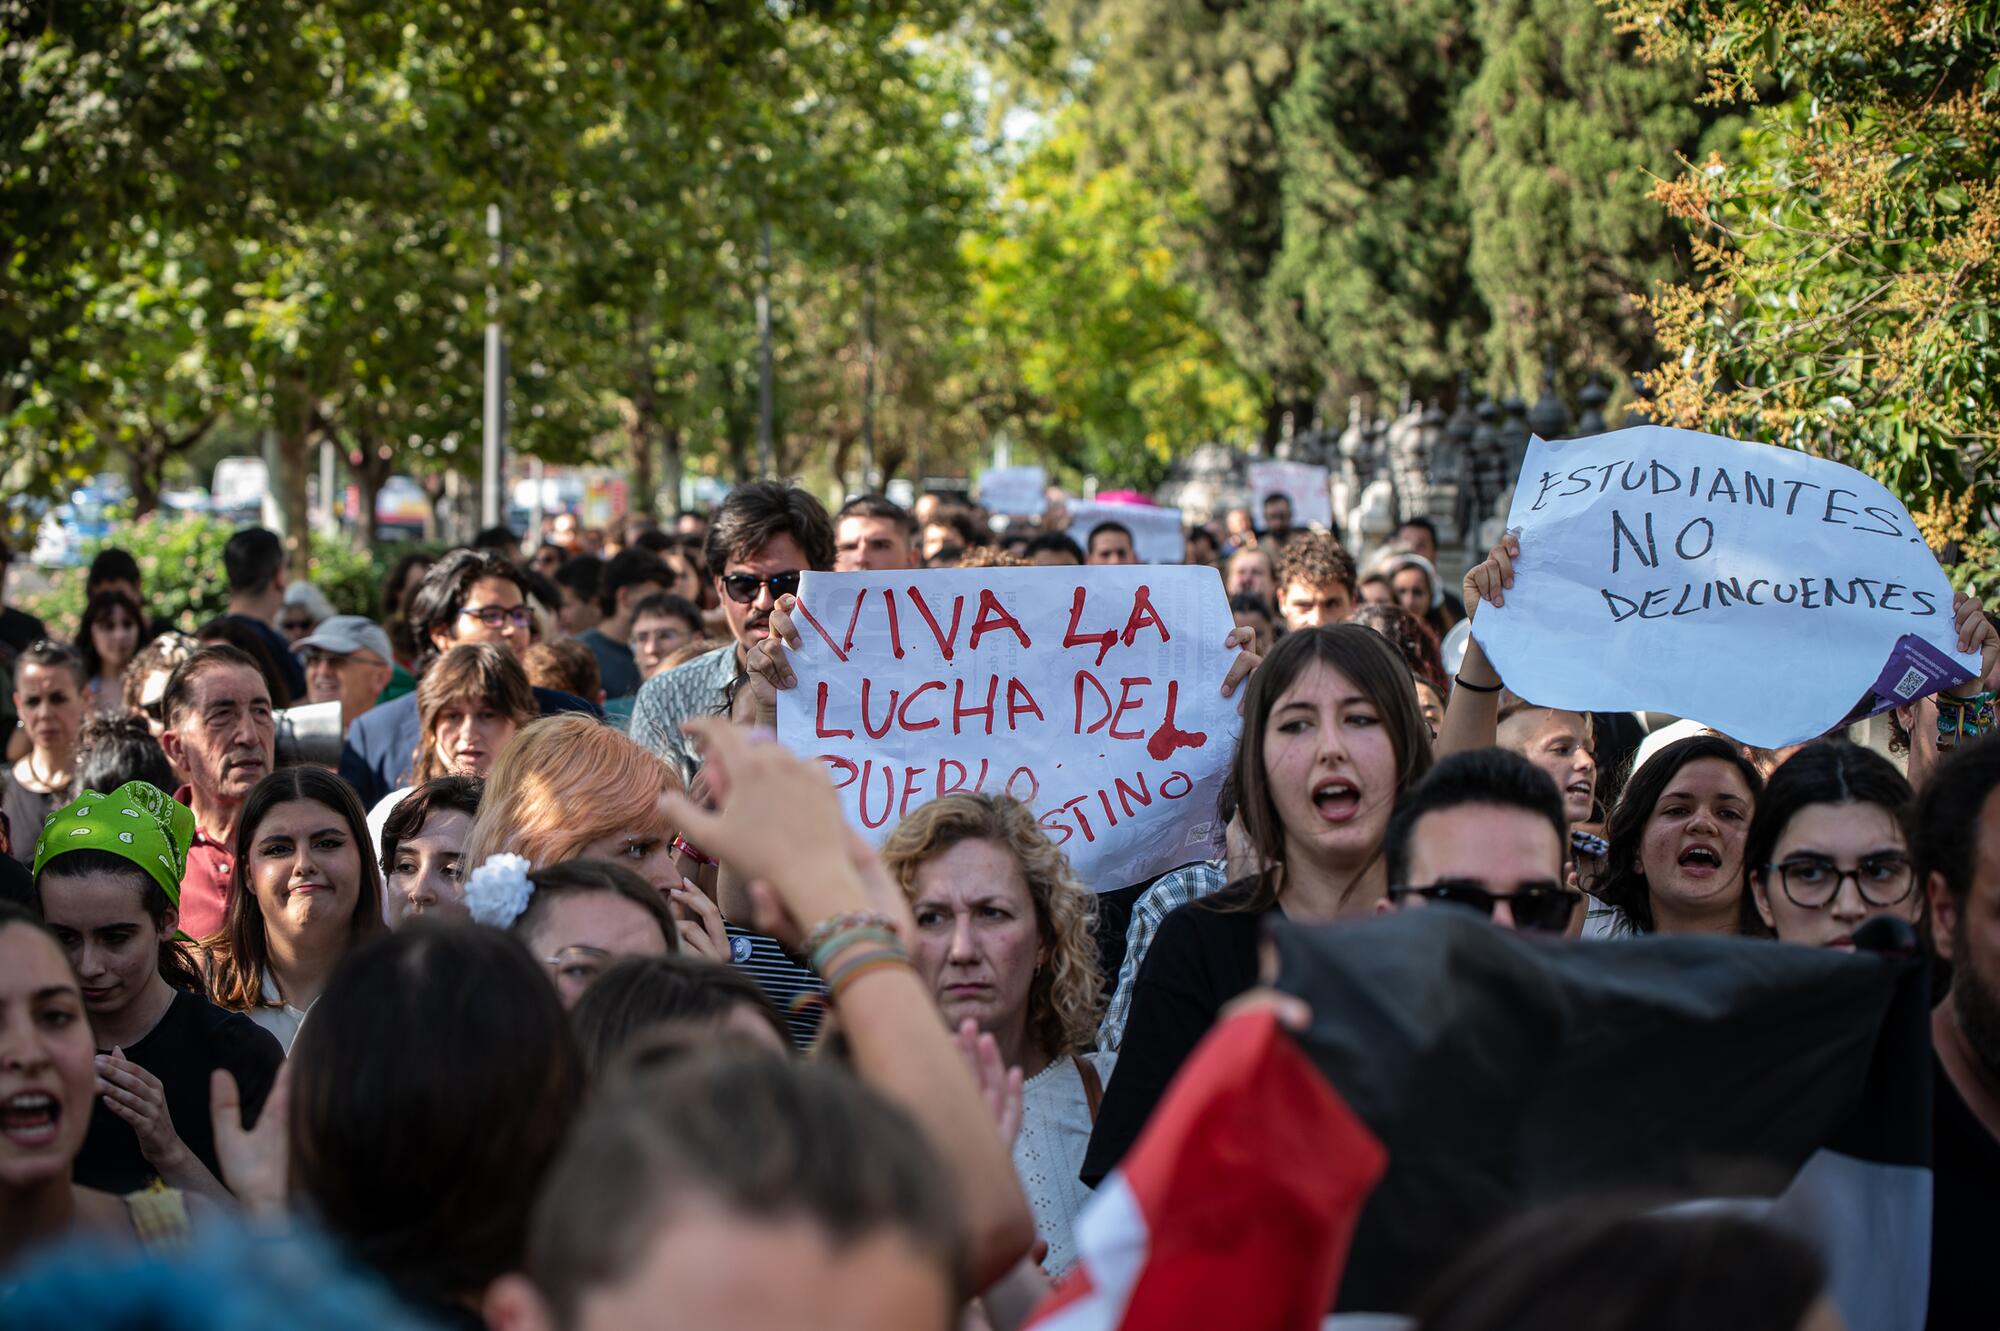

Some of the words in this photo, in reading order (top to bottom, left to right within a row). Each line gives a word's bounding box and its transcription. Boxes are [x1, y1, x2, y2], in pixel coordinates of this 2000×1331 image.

[1611, 509, 1714, 574] NO
[796, 585, 1032, 662] VIVA
[1062, 584, 1171, 667] LA
[1601, 576, 1937, 623] DELINCUENTES
[815, 673, 1044, 740] LUCHA
[1074, 669, 1208, 761] DEL
[1036, 770, 1194, 849] STINO
